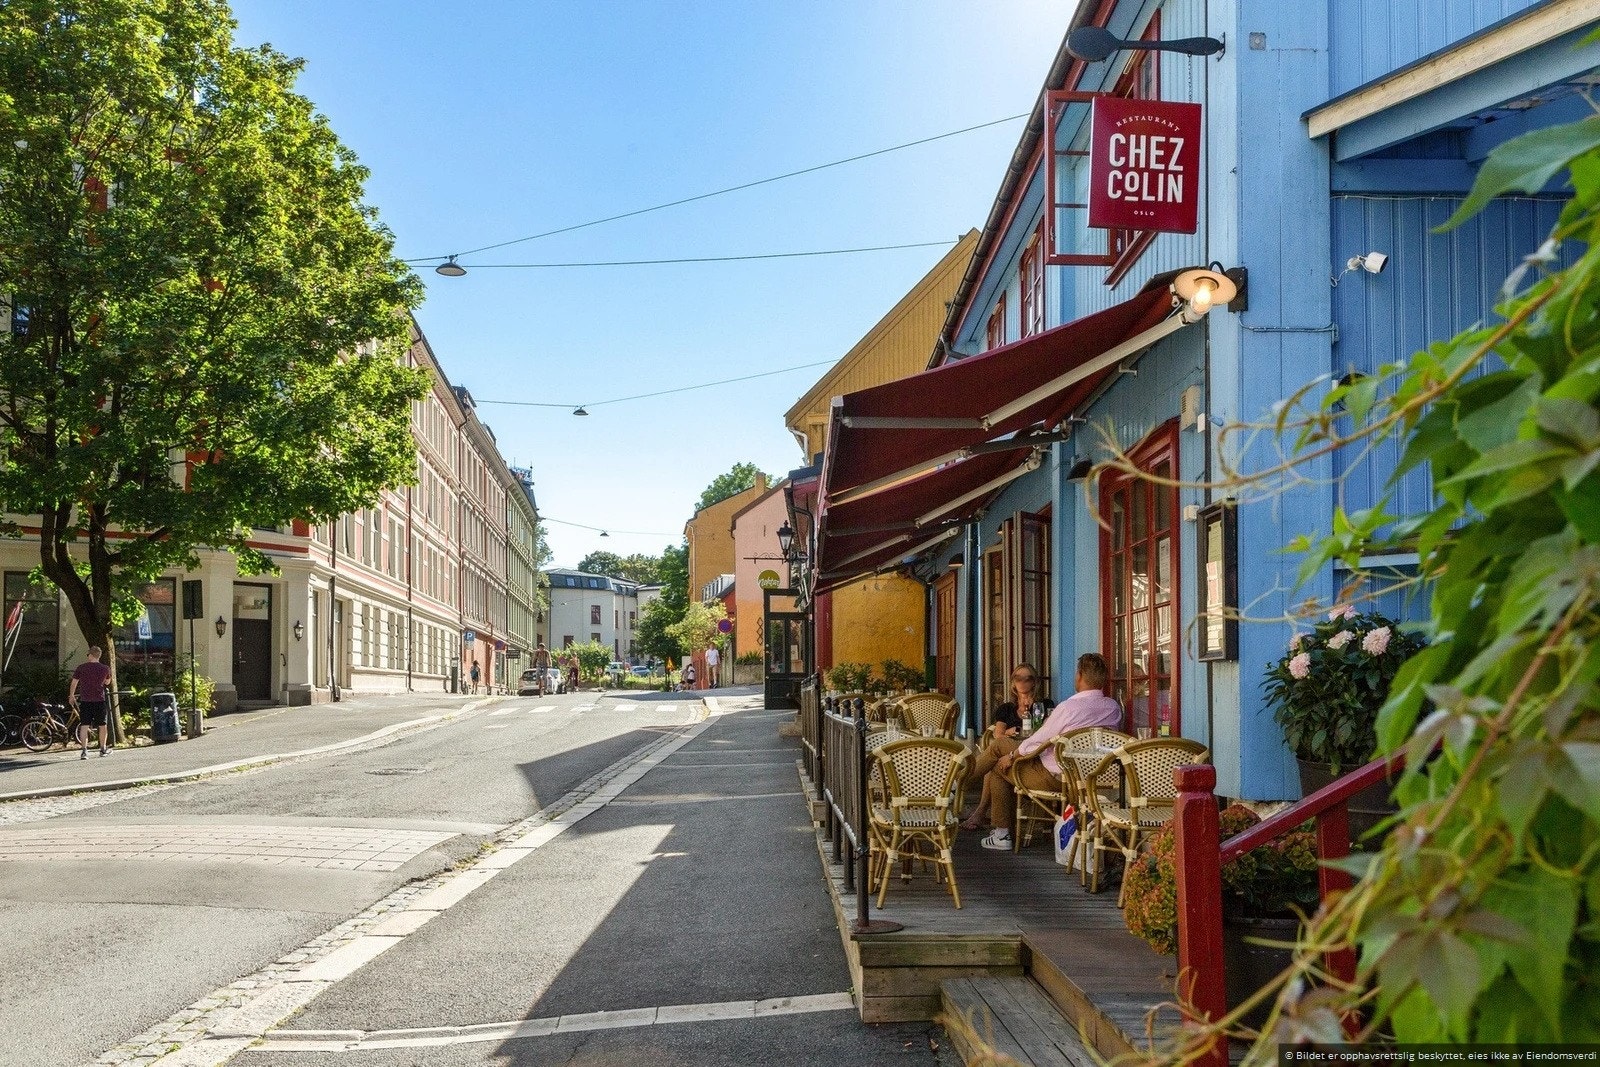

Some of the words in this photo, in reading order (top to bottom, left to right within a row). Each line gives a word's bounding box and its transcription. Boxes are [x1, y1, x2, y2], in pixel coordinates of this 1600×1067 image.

[1115, 115, 1180, 132] RESTAURANT
[1109, 133, 1185, 171] CHEZ
[466, 632, 473, 640] P
